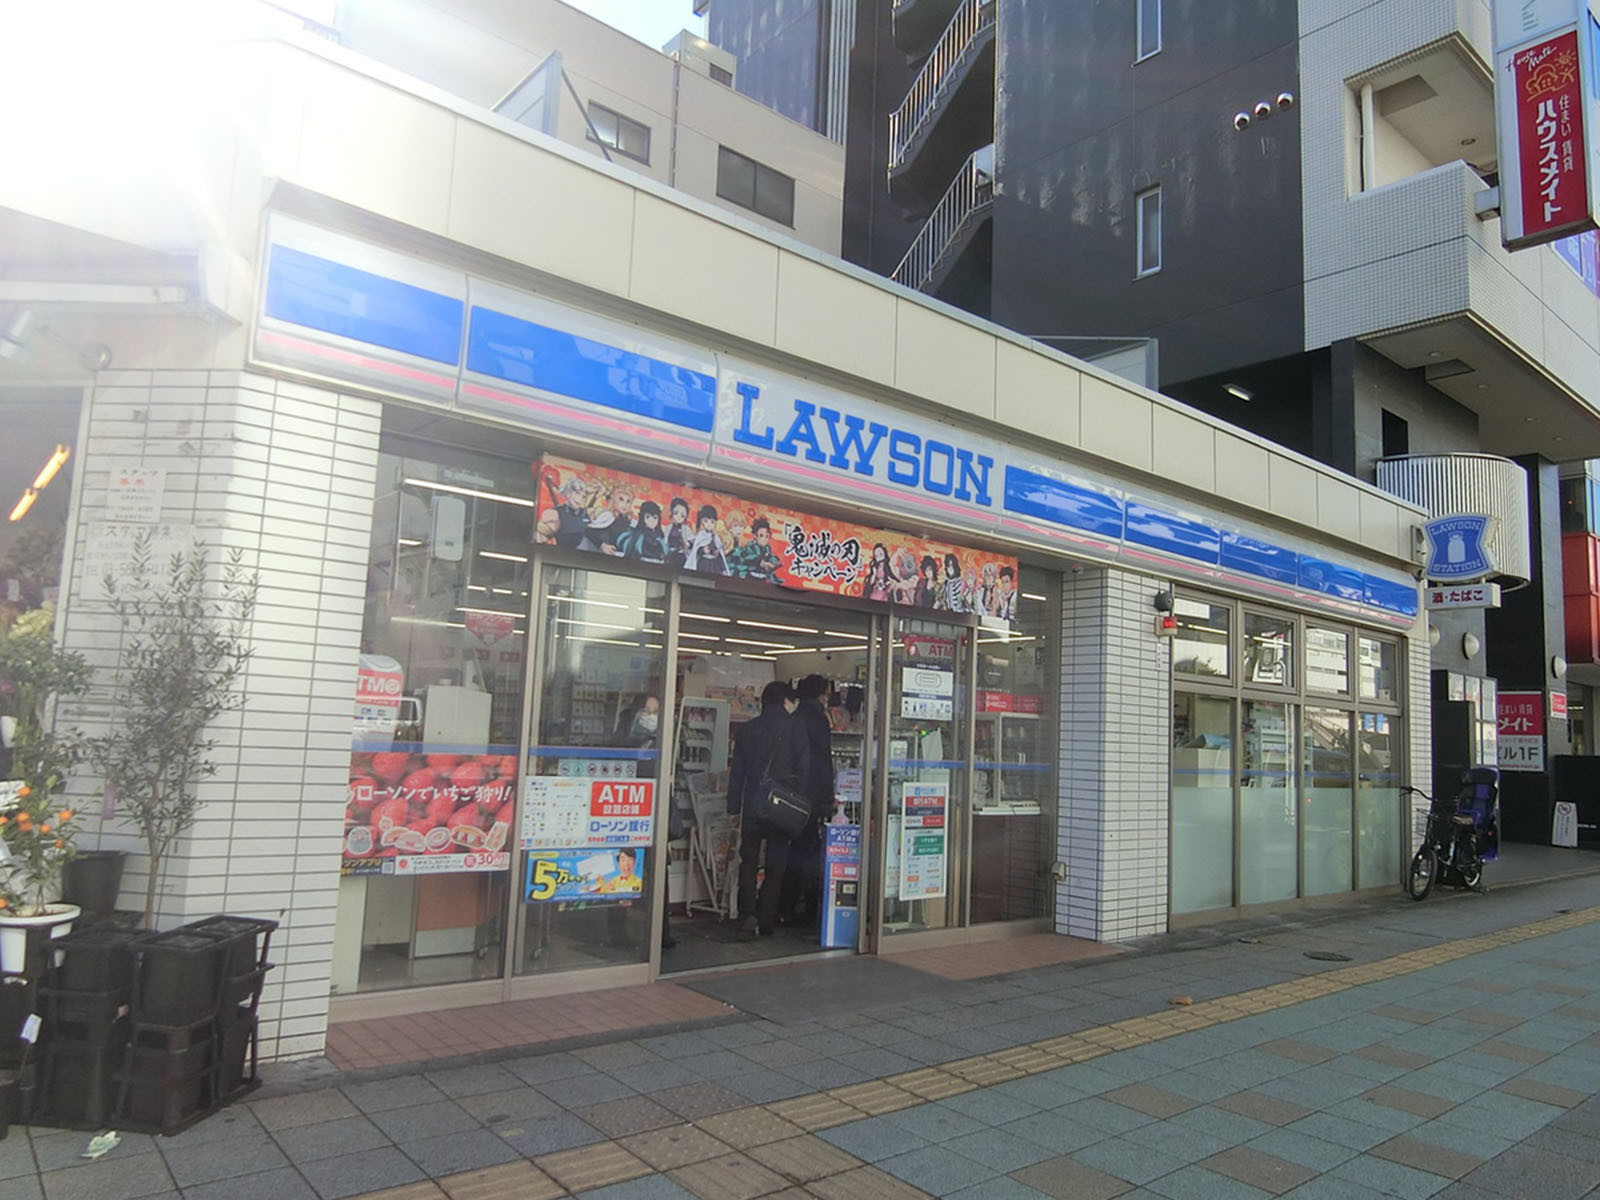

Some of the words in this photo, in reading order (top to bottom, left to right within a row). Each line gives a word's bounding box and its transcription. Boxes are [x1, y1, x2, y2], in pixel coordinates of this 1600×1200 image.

[1535, 98, 1562, 223] ハウスメイト
[733, 381, 994, 507] LAWSON
[1431, 520, 1481, 535] LAWSON
[791, 558, 856, 583] キャンペーン
[1432, 558, 1482, 573] STATION
[597, 784, 646, 804] ATM
